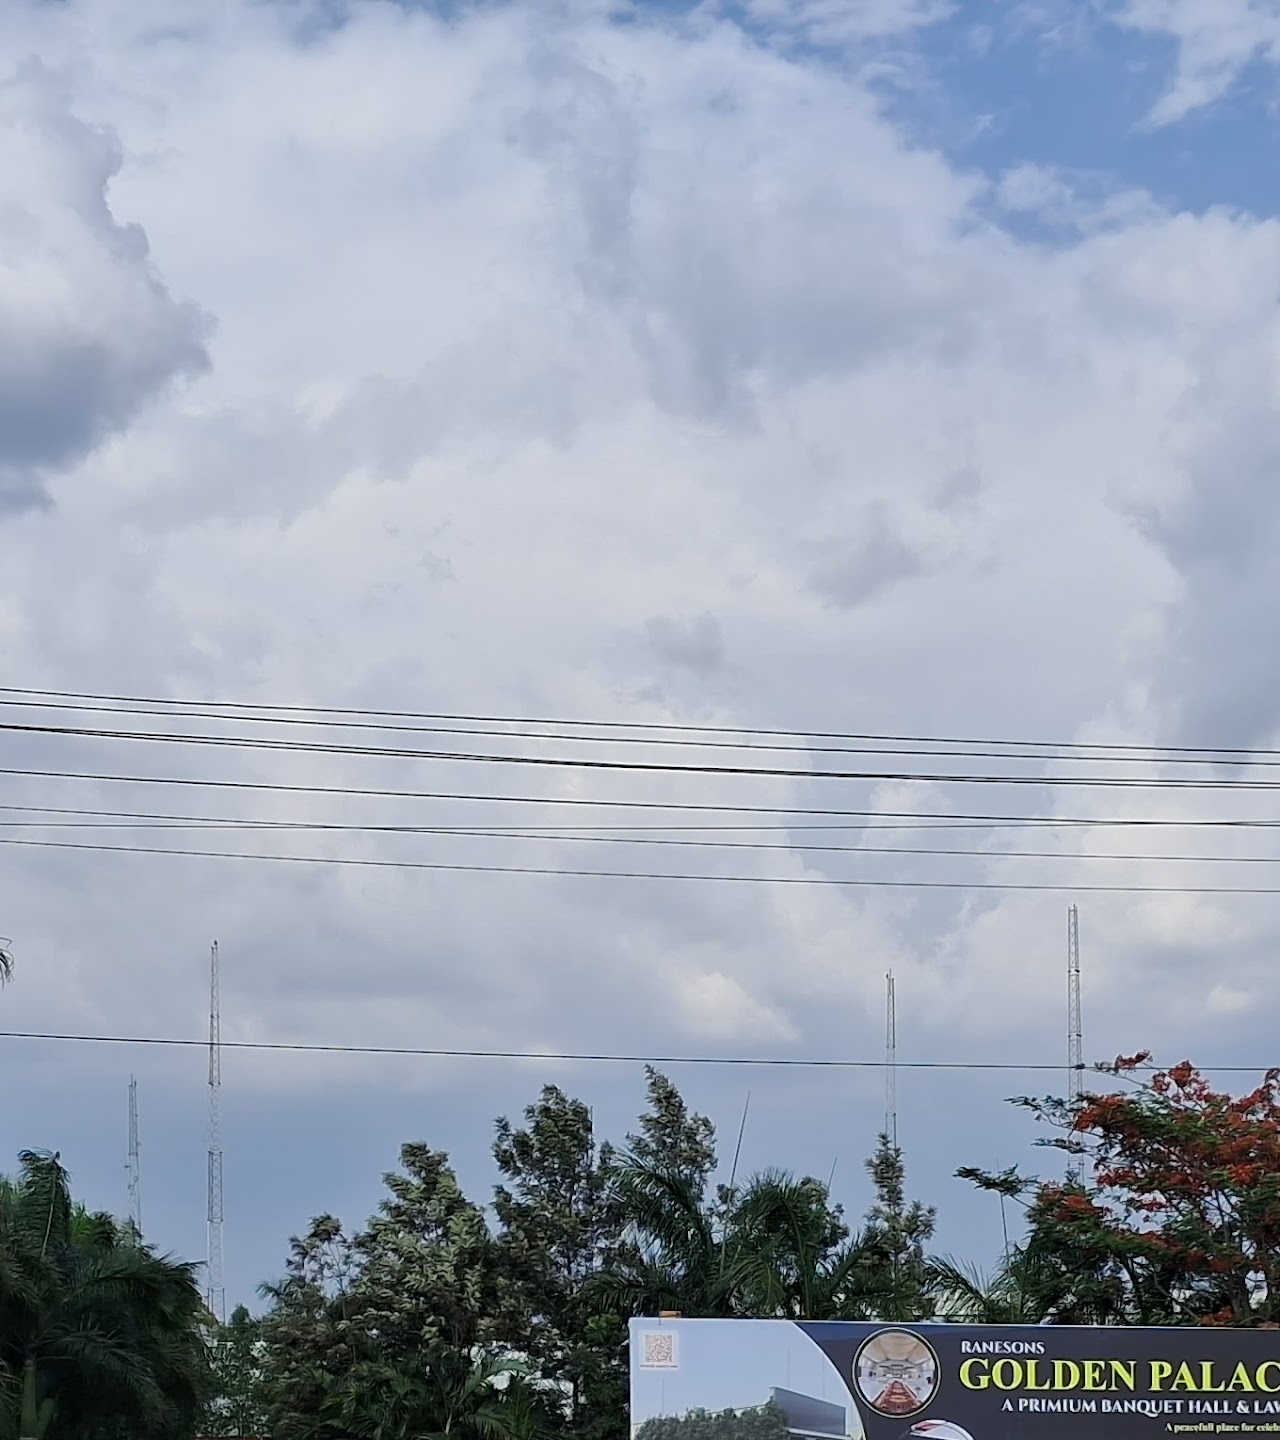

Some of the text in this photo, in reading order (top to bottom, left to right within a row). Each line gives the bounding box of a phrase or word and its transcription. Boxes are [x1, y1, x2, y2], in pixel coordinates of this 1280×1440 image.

[961, 1340, 1045, 1355] RANESONS
[959, 1357, 1137, 1391] GOLDEN
[1001, 1398, 1014, 1412] A
[1018, 1397, 1097, 1413] PRIMIUM
[1101, 1398, 1185, 1418] BANQUET
[1188, 1399, 1233, 1414] HALL
[1235, 1399, 1251, 1414] &
[1216, 1422, 1240, 1434] place
[1241, 1422, 1255, 1433] for
